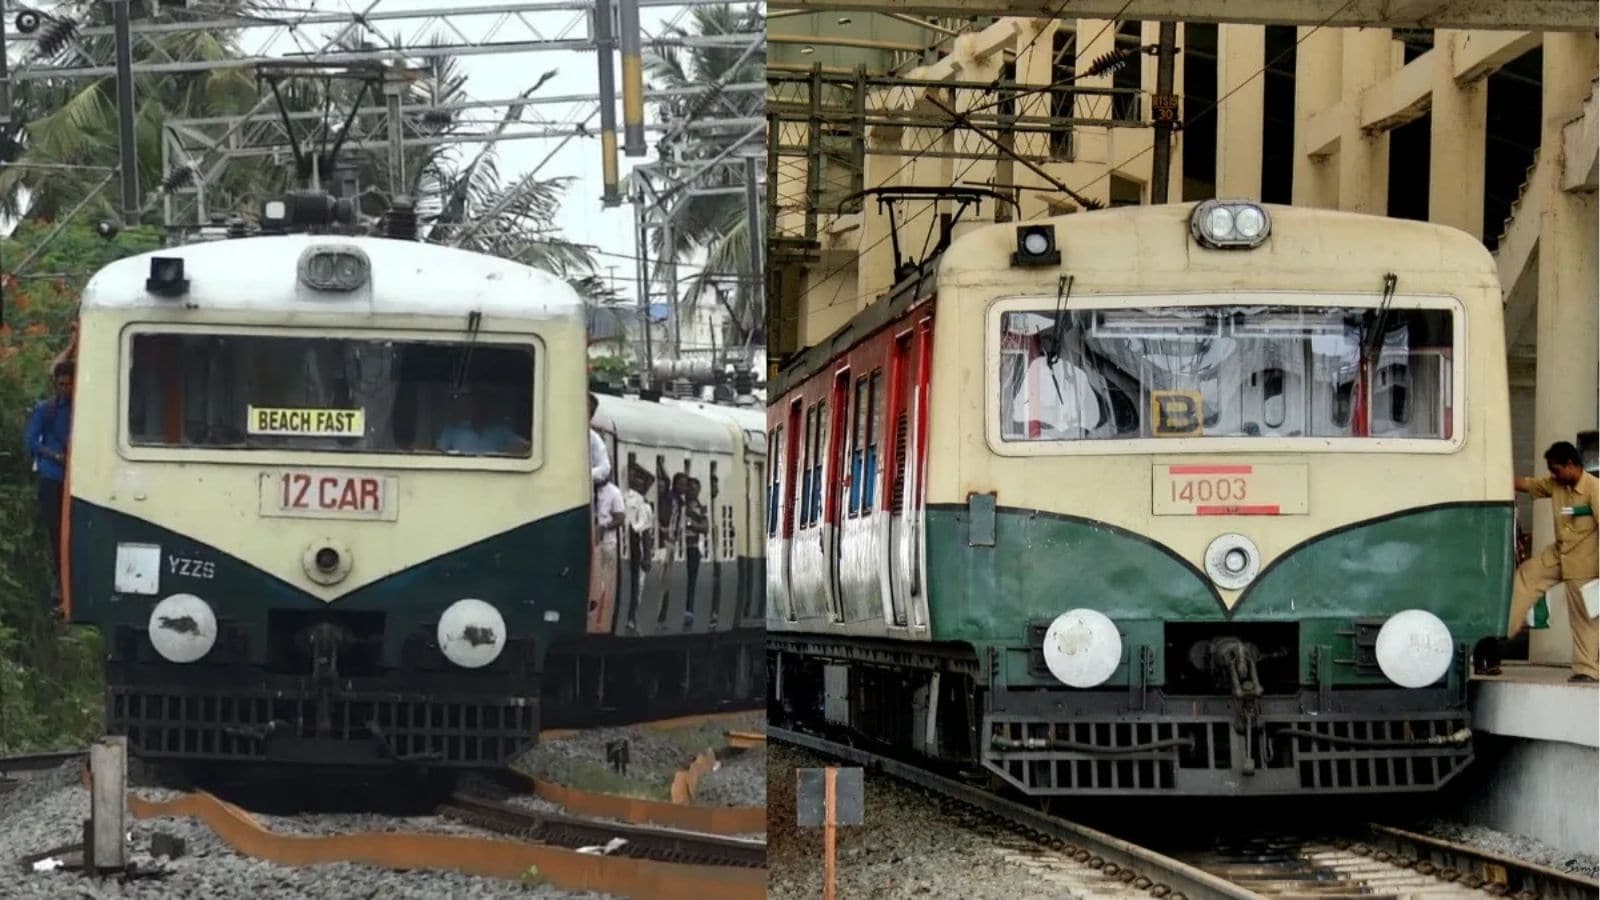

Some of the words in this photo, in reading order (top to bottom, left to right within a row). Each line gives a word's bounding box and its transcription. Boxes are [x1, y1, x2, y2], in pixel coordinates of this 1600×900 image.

[258, 410, 311, 431] BEACH
[316, 412, 355, 433] FAST
[1156, 394, 1200, 433] B
[281, 472, 312, 508] 12
[319, 476, 379, 511] CAR
[1171, 478, 1246, 503] 14003
